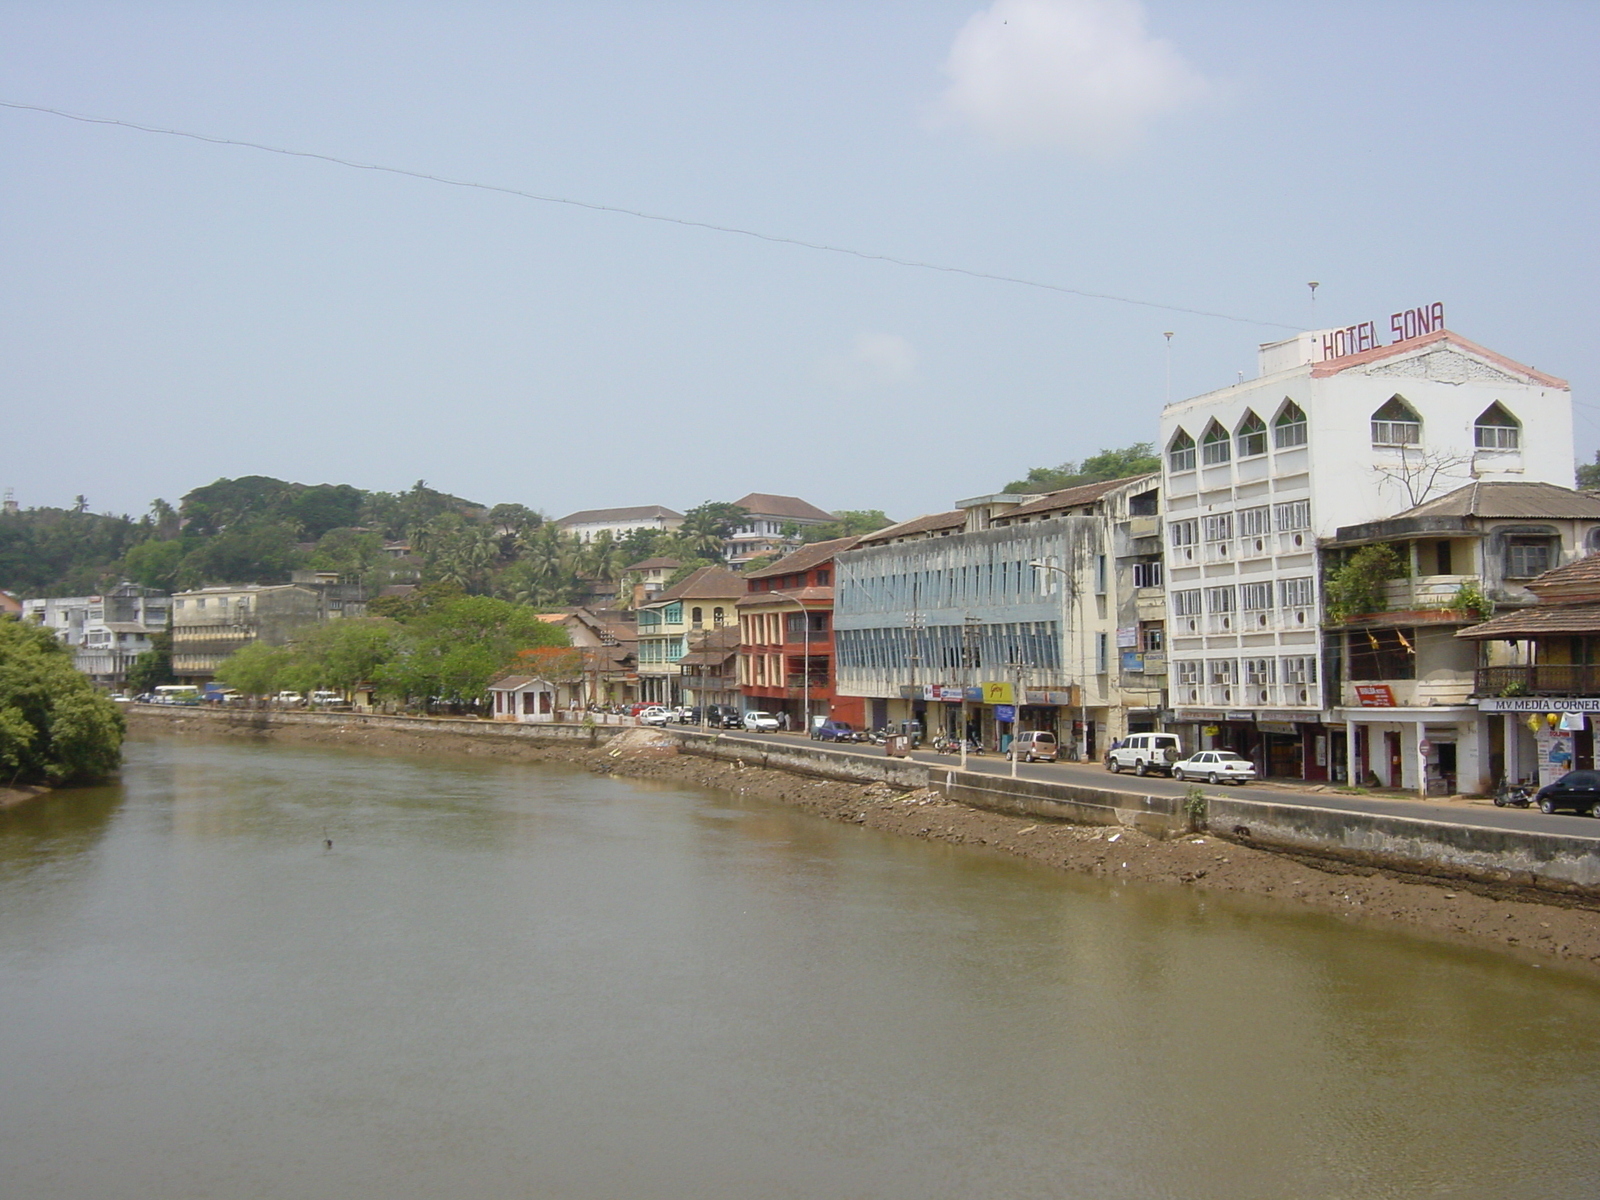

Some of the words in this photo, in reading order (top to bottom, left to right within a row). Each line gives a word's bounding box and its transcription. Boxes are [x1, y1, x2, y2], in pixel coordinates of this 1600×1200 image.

[1323, 321, 1382, 361] HOTEL
[1391, 302, 1444, 344] SONA
[1515, 700, 1550, 710] MEDIA
[1553, 700, 1600, 710] CORNER
